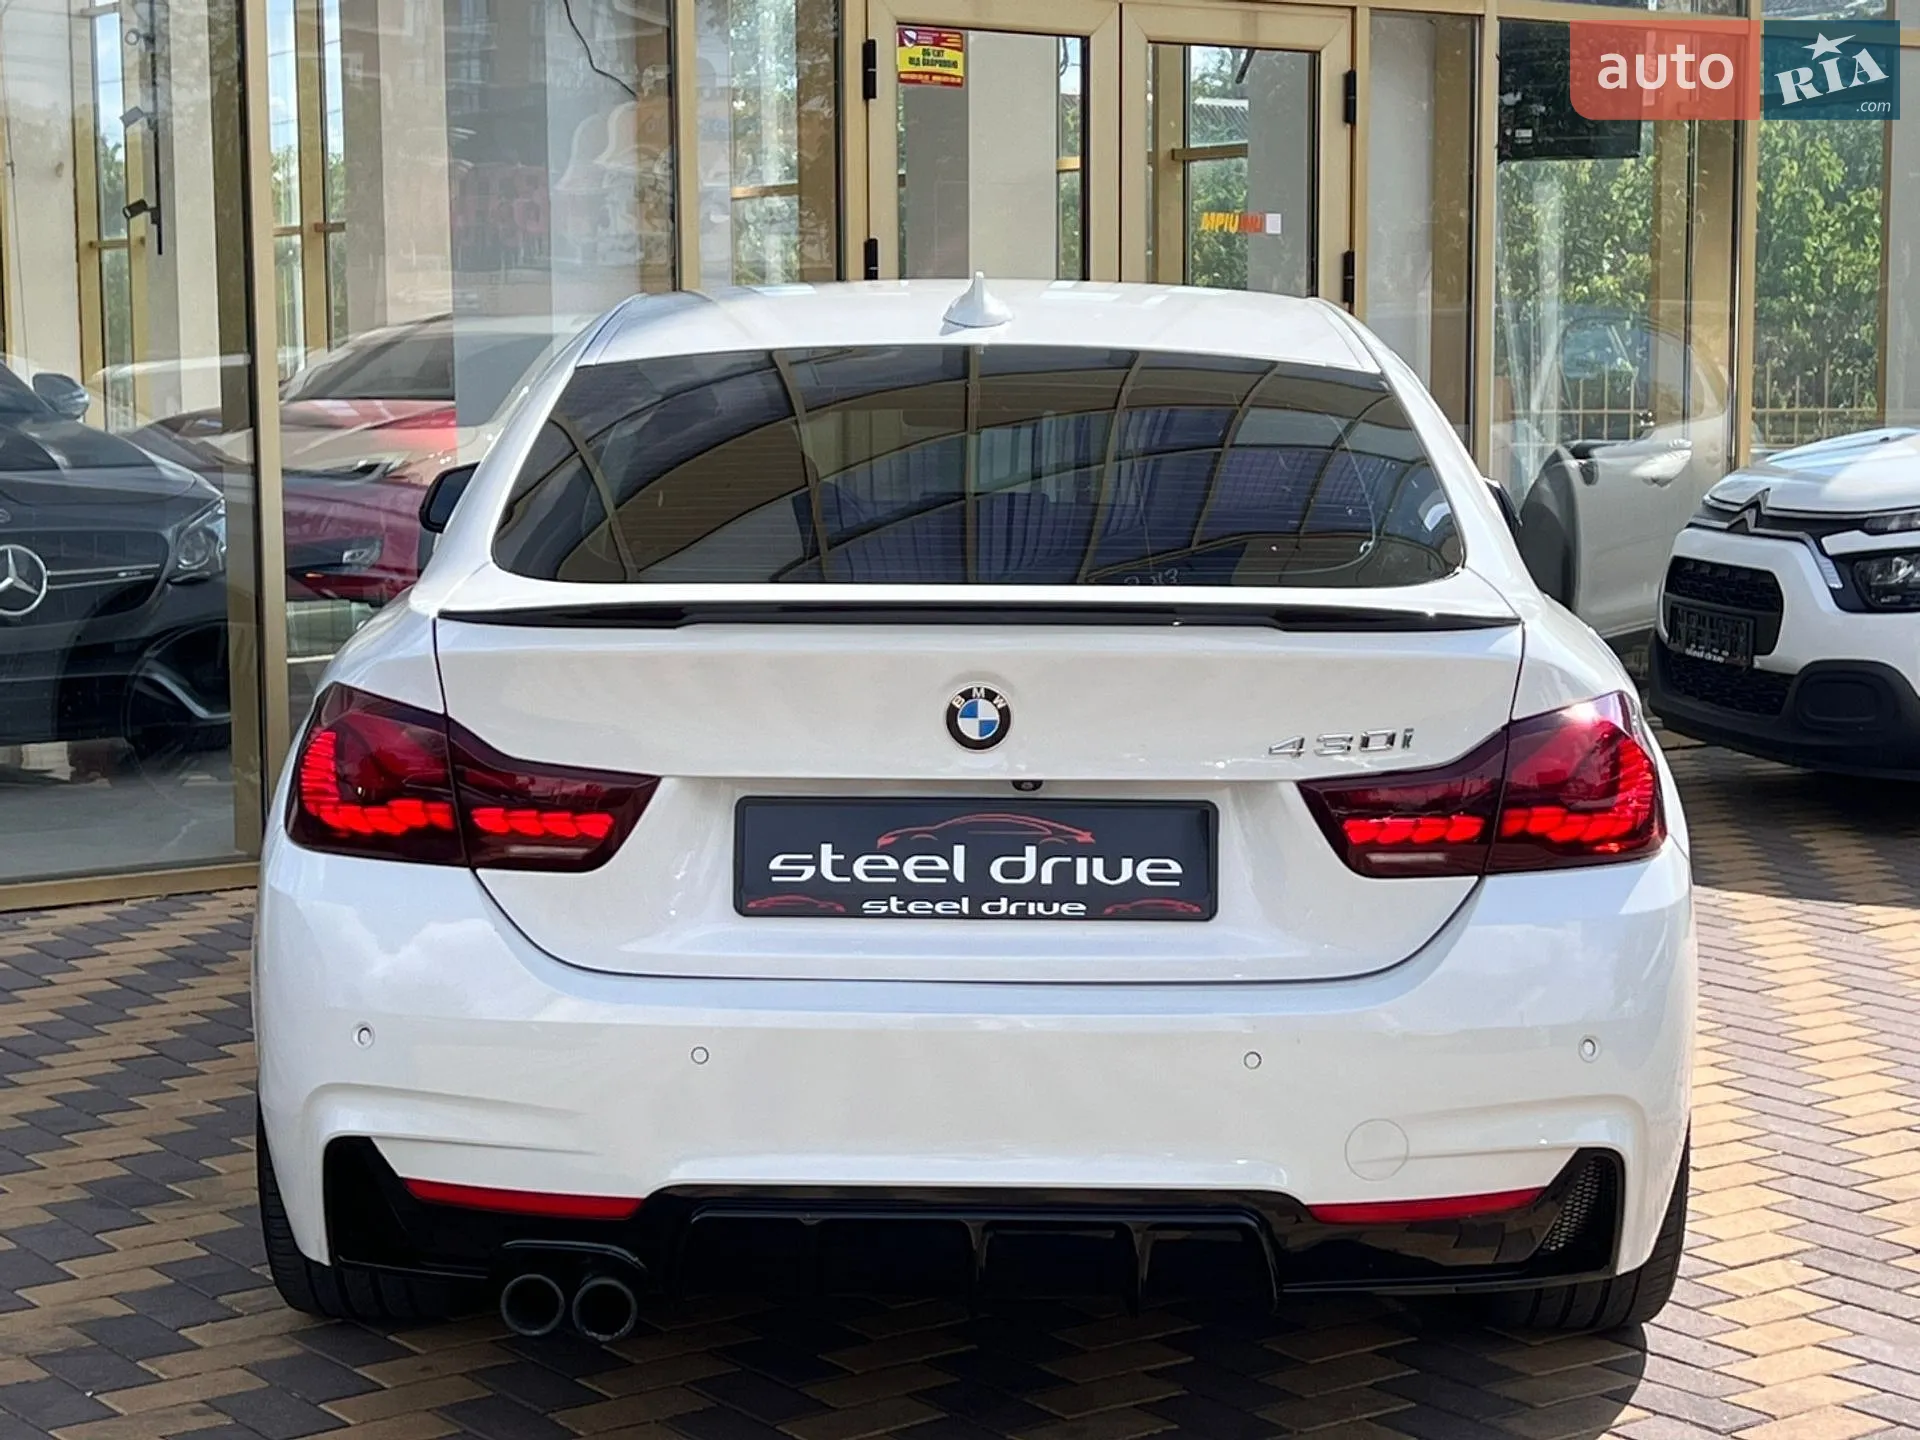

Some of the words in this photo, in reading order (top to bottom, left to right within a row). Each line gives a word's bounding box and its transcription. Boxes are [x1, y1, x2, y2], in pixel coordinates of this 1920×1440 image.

[951, 687, 1006, 709] BMW
[1268, 728, 1414, 757] 430i
[768, 843, 965, 884] steel
[989, 845, 1184, 887] drive
[861, 896, 969, 915] steel
[980, 897, 1088, 917] drive
